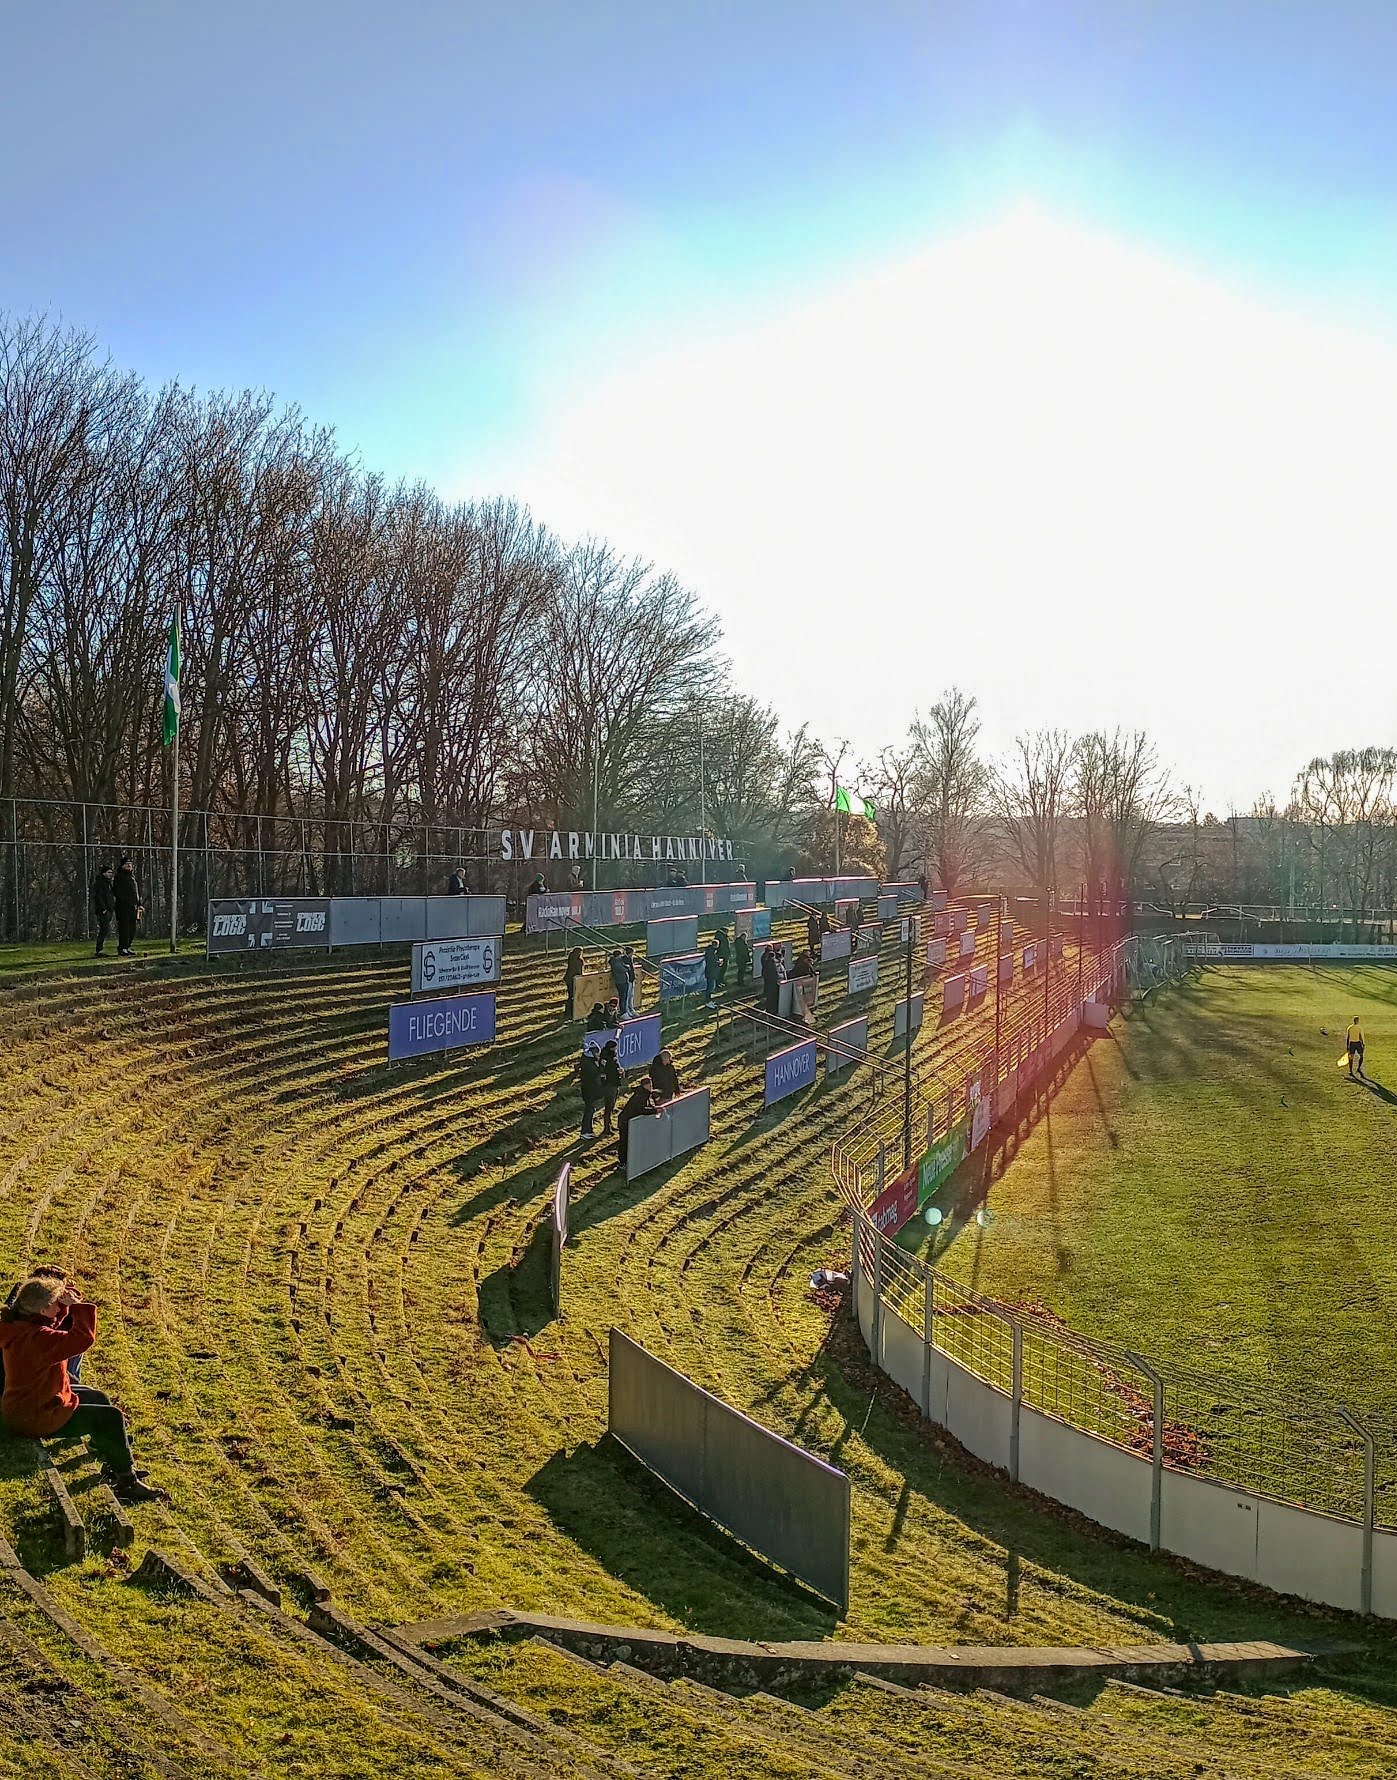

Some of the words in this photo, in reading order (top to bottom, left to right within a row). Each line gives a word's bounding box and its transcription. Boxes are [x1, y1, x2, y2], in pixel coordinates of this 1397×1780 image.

[501, 830, 534, 861] SV
[550, 831, 641, 860] ARMINIA
[652, 836, 734, 861] HANNOVER
[409, 1007, 477, 1041] FLIEGENDE
[619, 1030, 642, 1058] UTEN
[774, 1052, 810, 1088] HANNOVER
